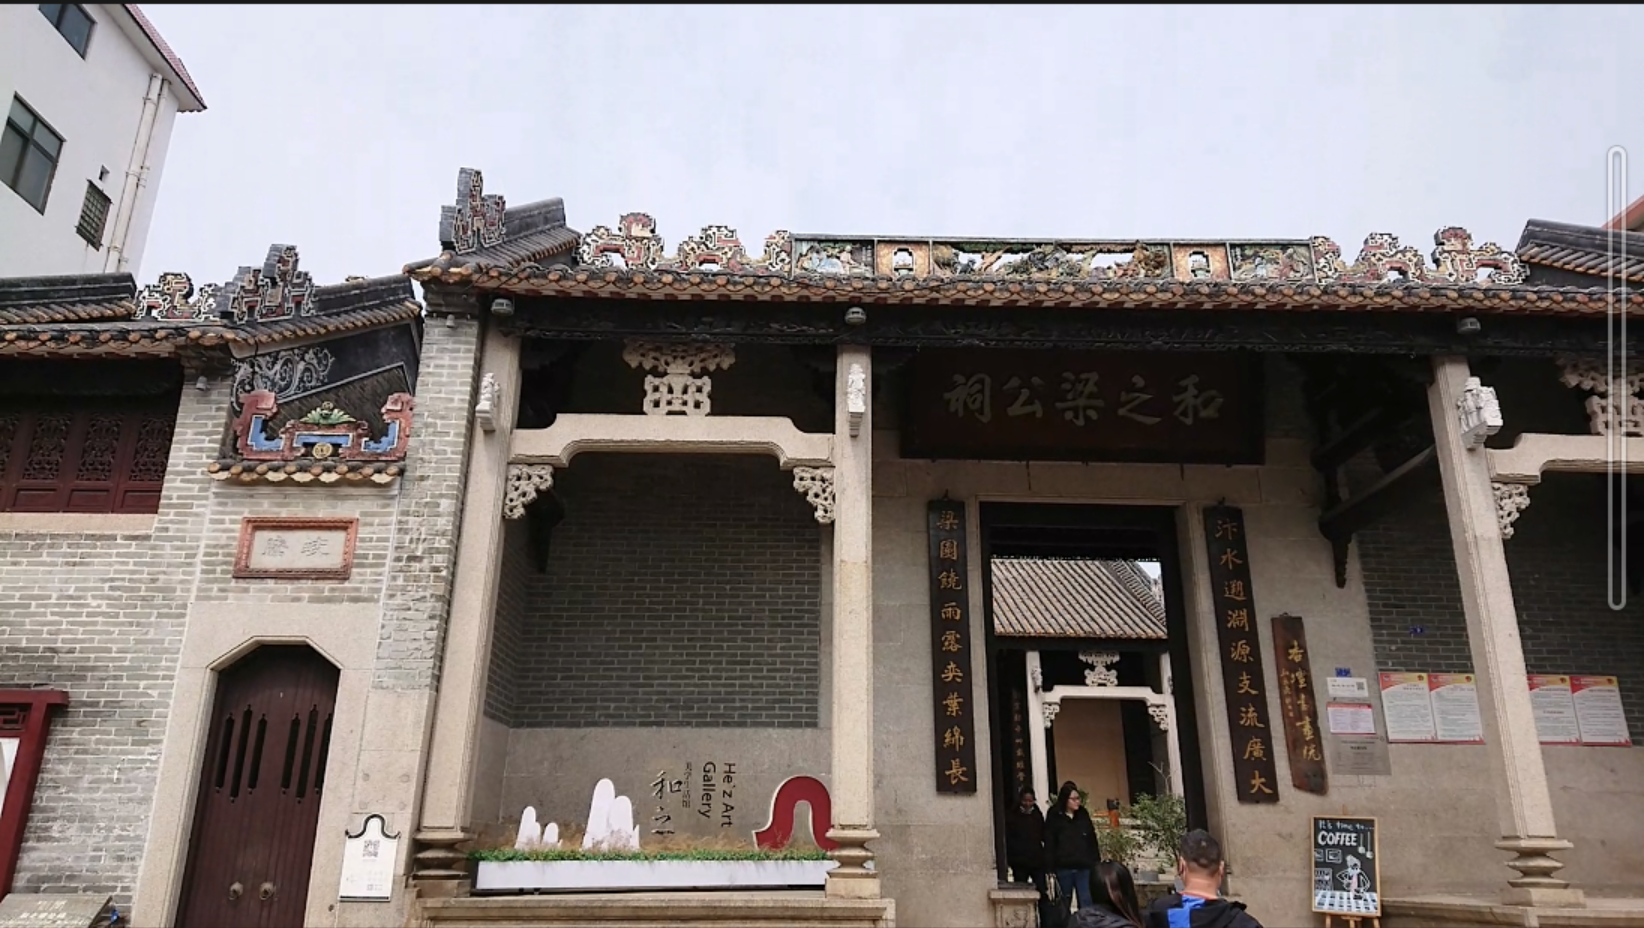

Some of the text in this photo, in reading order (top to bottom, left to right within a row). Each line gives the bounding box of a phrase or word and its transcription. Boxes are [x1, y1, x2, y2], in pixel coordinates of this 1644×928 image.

[943, 371, 1225, 426] 和之梁公祠
[697, 761, 717, 819] Gallery
[721, 802, 735, 828] Art
[1317, 830, 1357, 846] COFFEE
